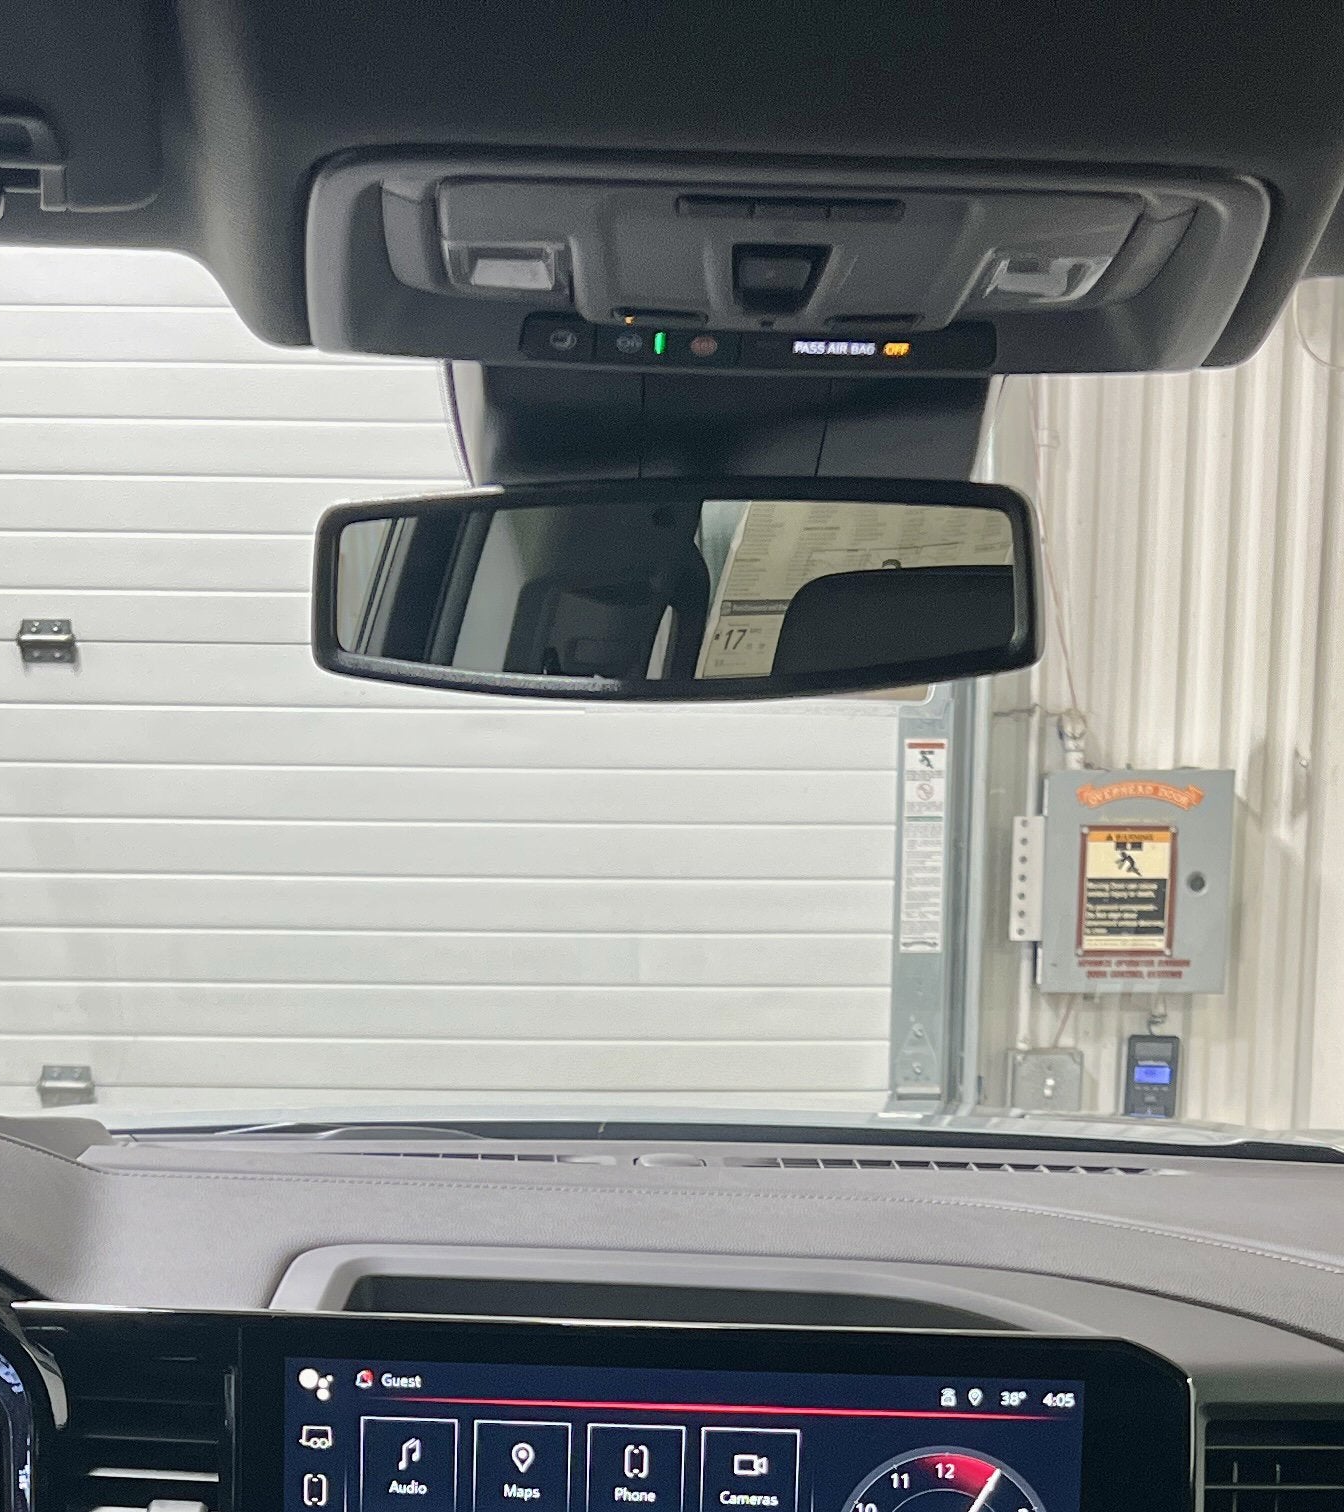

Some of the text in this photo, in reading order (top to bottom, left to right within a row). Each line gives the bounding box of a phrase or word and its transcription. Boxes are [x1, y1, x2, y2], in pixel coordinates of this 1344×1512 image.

[793, 341, 911, 356] PASS AIR BAG OFF
[381, 1373, 422, 1389] Guest
[1042, 1392, 1076, 1409] 4:05
[934, 1463, 956, 1480] 12
[389, 1479, 428, 1496] Audio
[890, 1472, 910, 1488] 11
[503, 1484, 541, 1502] Maps
[614, 1487, 657, 1503] Phone
[719, 1491, 780, 1507] Cameras
